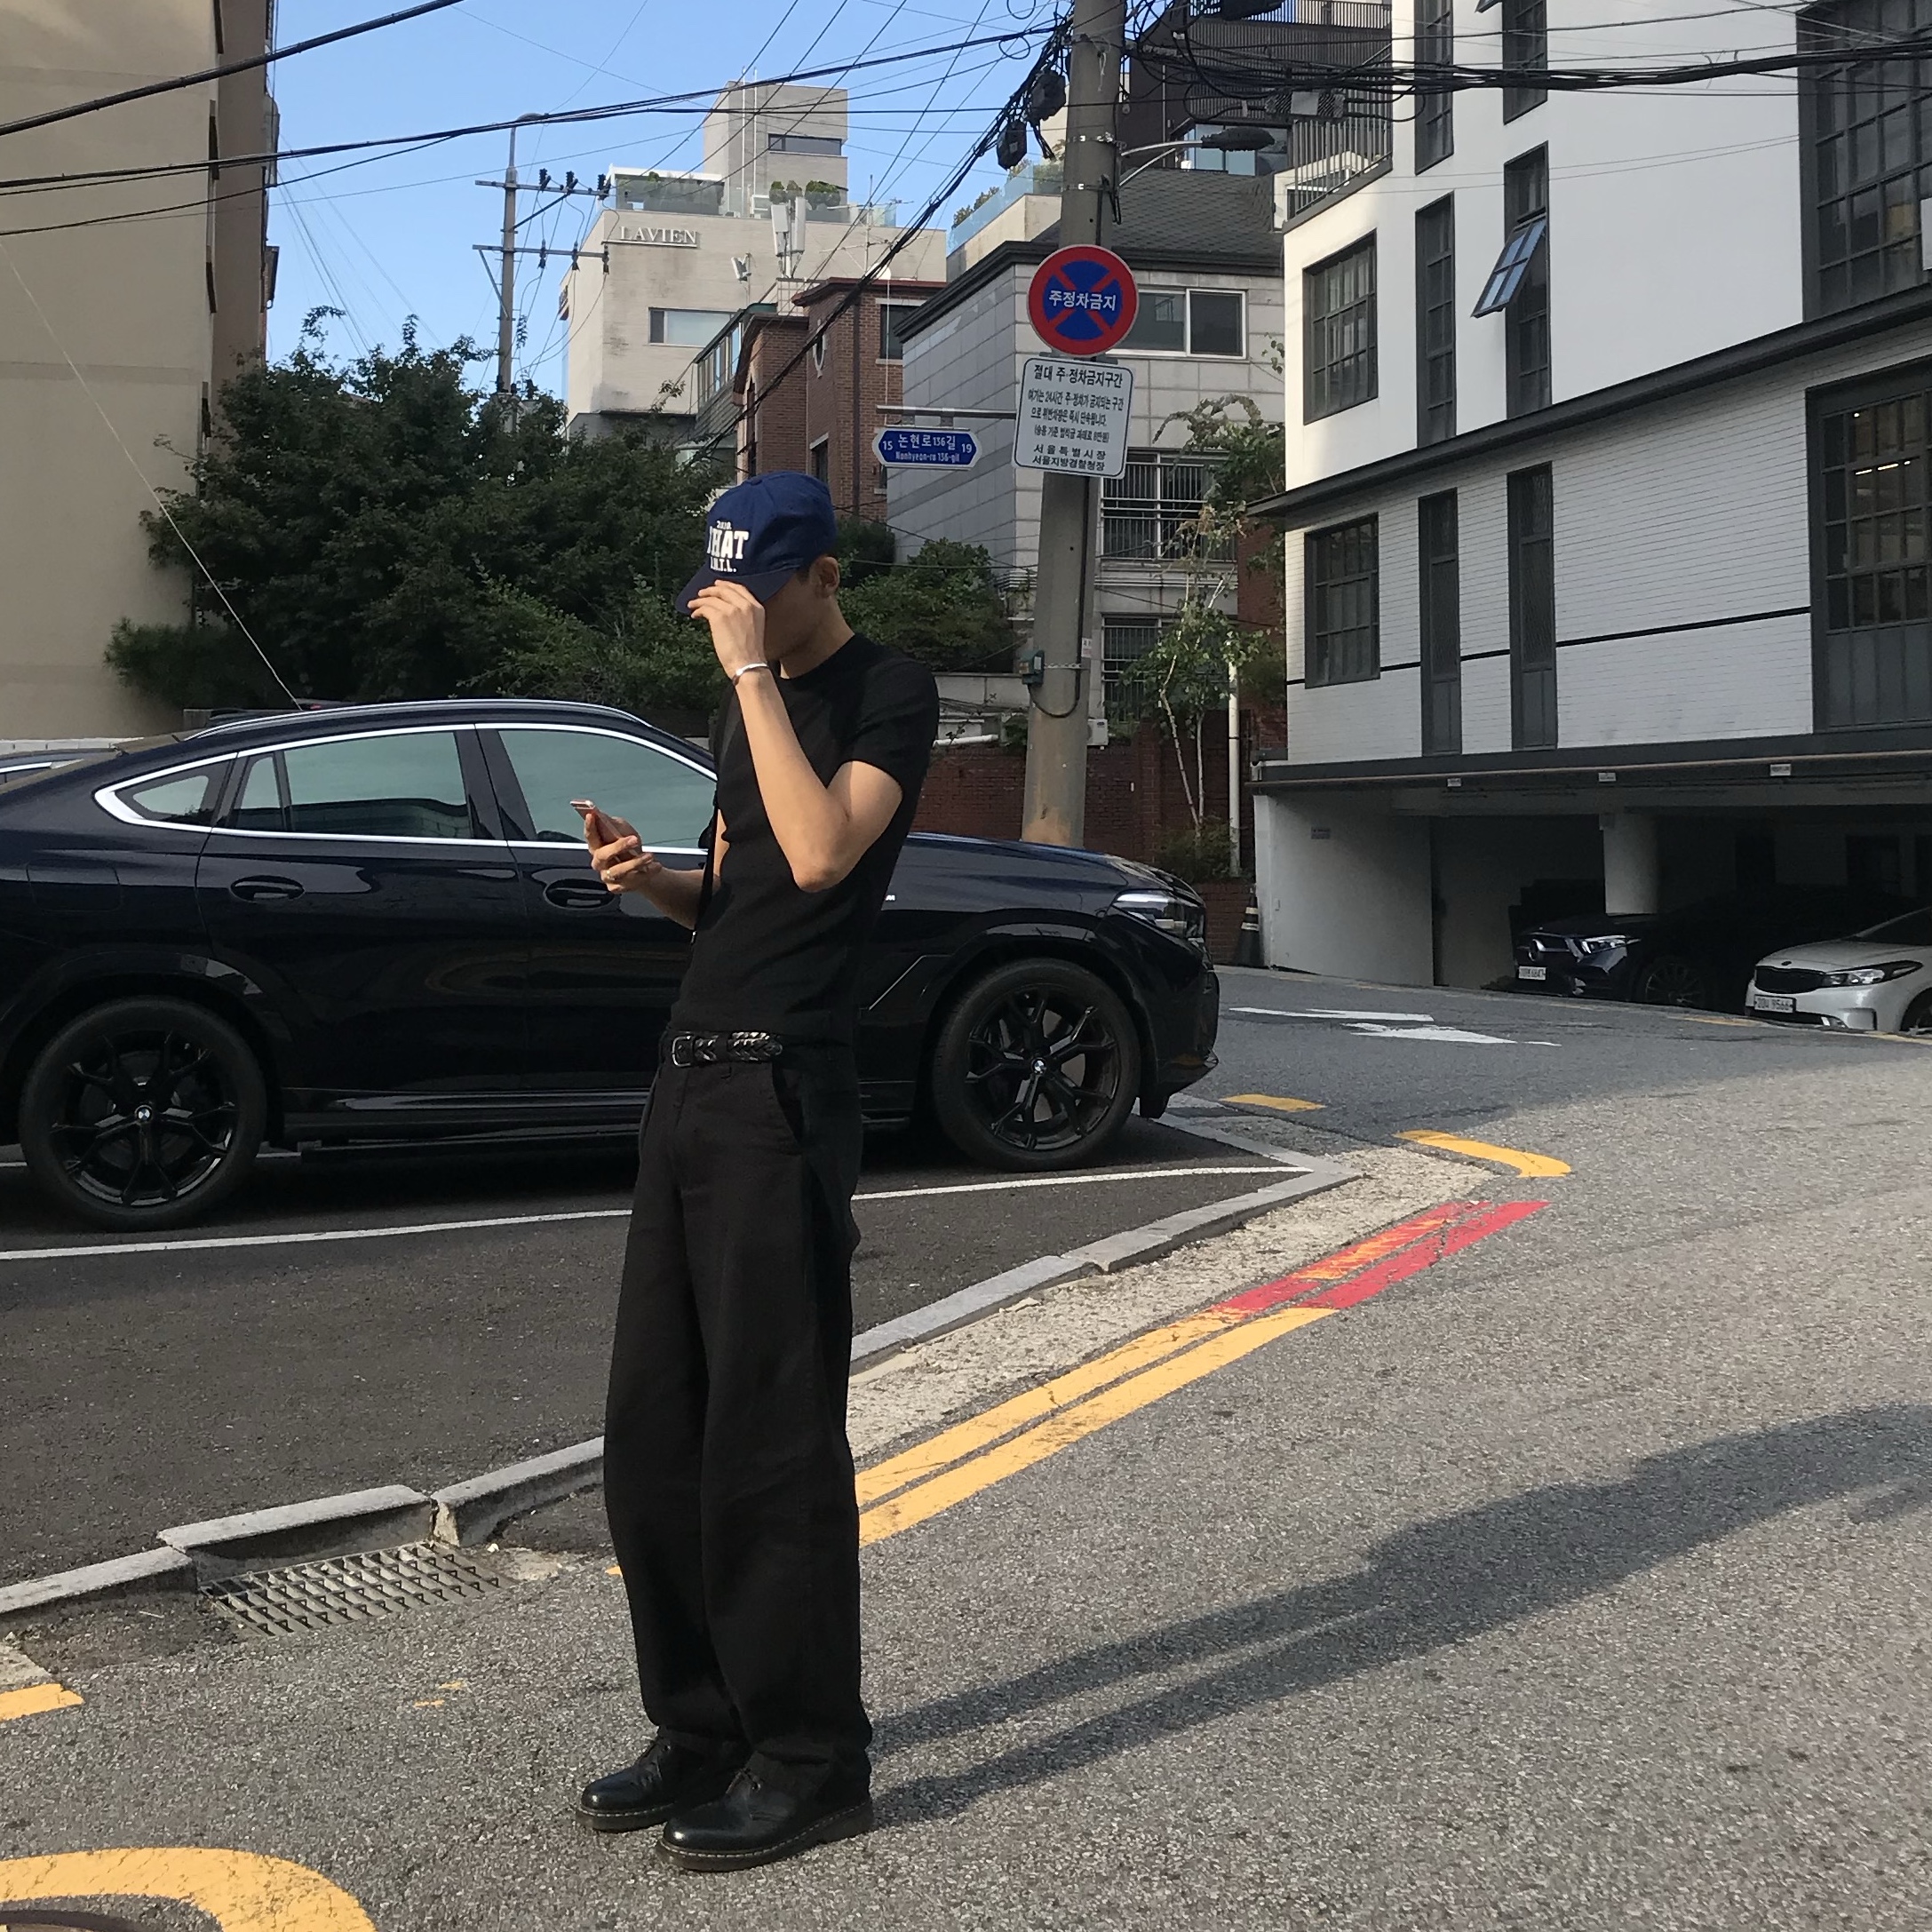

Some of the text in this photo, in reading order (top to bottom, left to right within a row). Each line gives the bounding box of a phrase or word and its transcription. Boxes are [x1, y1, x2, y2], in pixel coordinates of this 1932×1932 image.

[620, 226, 696, 244] LAVIEN
[1049, 290, 1117, 311] 주정차금지
[1034, 364, 1053, 381] 절대
[1112, 397, 1124, 411] 구간
[1030, 407, 1041, 418] 으로
[882, 441, 894, 450] 15
[961, 443, 972, 453] 19
[1032, 455, 1105, 471] 서울지방경찰청장
